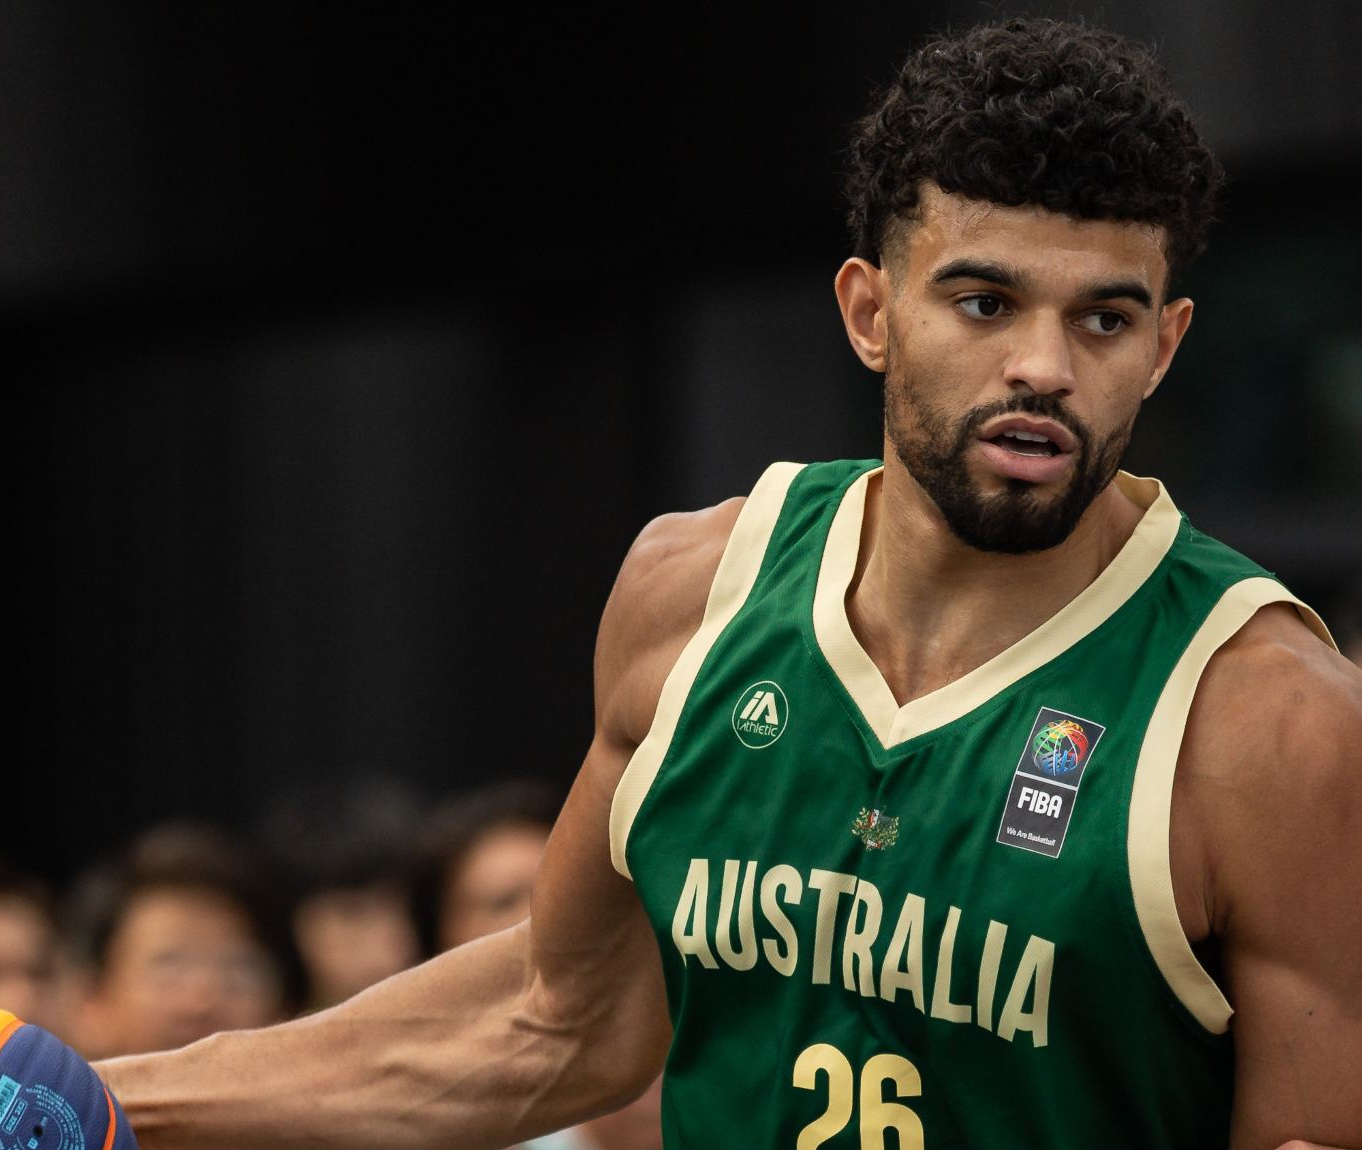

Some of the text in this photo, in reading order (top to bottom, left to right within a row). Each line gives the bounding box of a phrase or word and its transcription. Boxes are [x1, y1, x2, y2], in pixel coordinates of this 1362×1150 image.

[1017, 786, 1063, 819] FIBA
[1006, 826, 1017, 836] We
[1016, 830, 1028, 839] Are
[672, 857, 1056, 1048] AUSTRALIA
